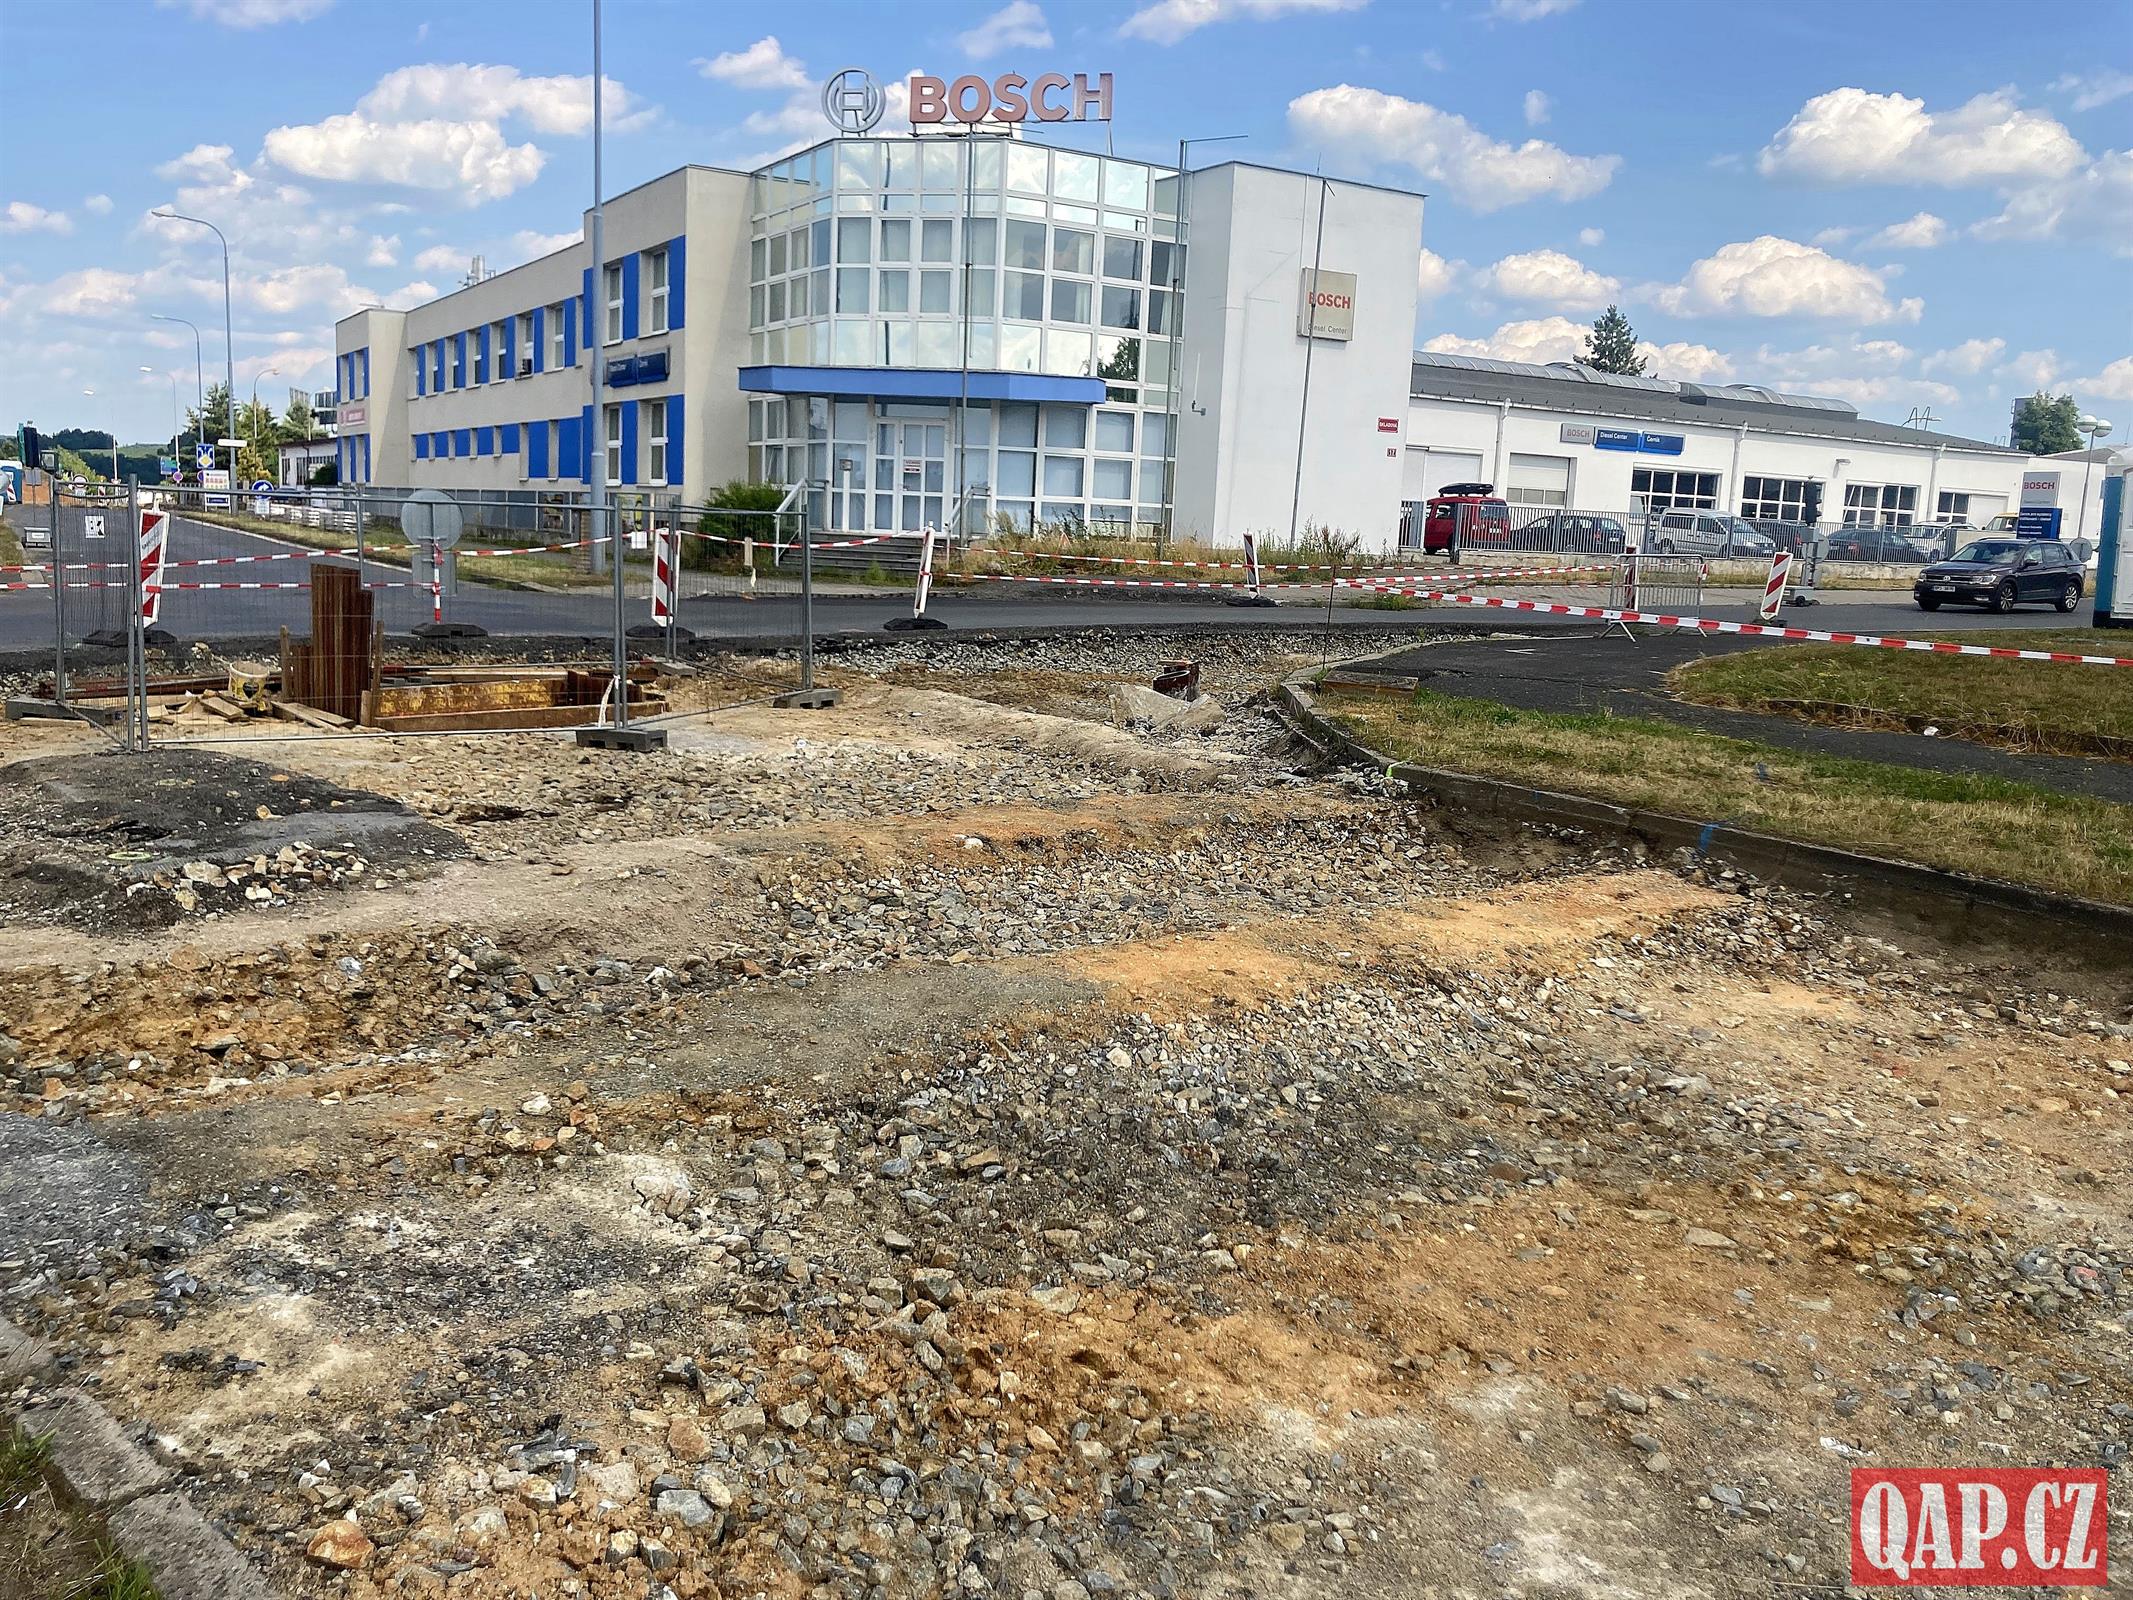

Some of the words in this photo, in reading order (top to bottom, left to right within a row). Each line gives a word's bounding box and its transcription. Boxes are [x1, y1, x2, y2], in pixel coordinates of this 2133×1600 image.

[910, 73, 1113, 123] BOSCH
[1327, 325, 1348, 335] Center
[1567, 428, 1590, 438] BOSCH
[2023, 481, 2055, 490] BOSCH
